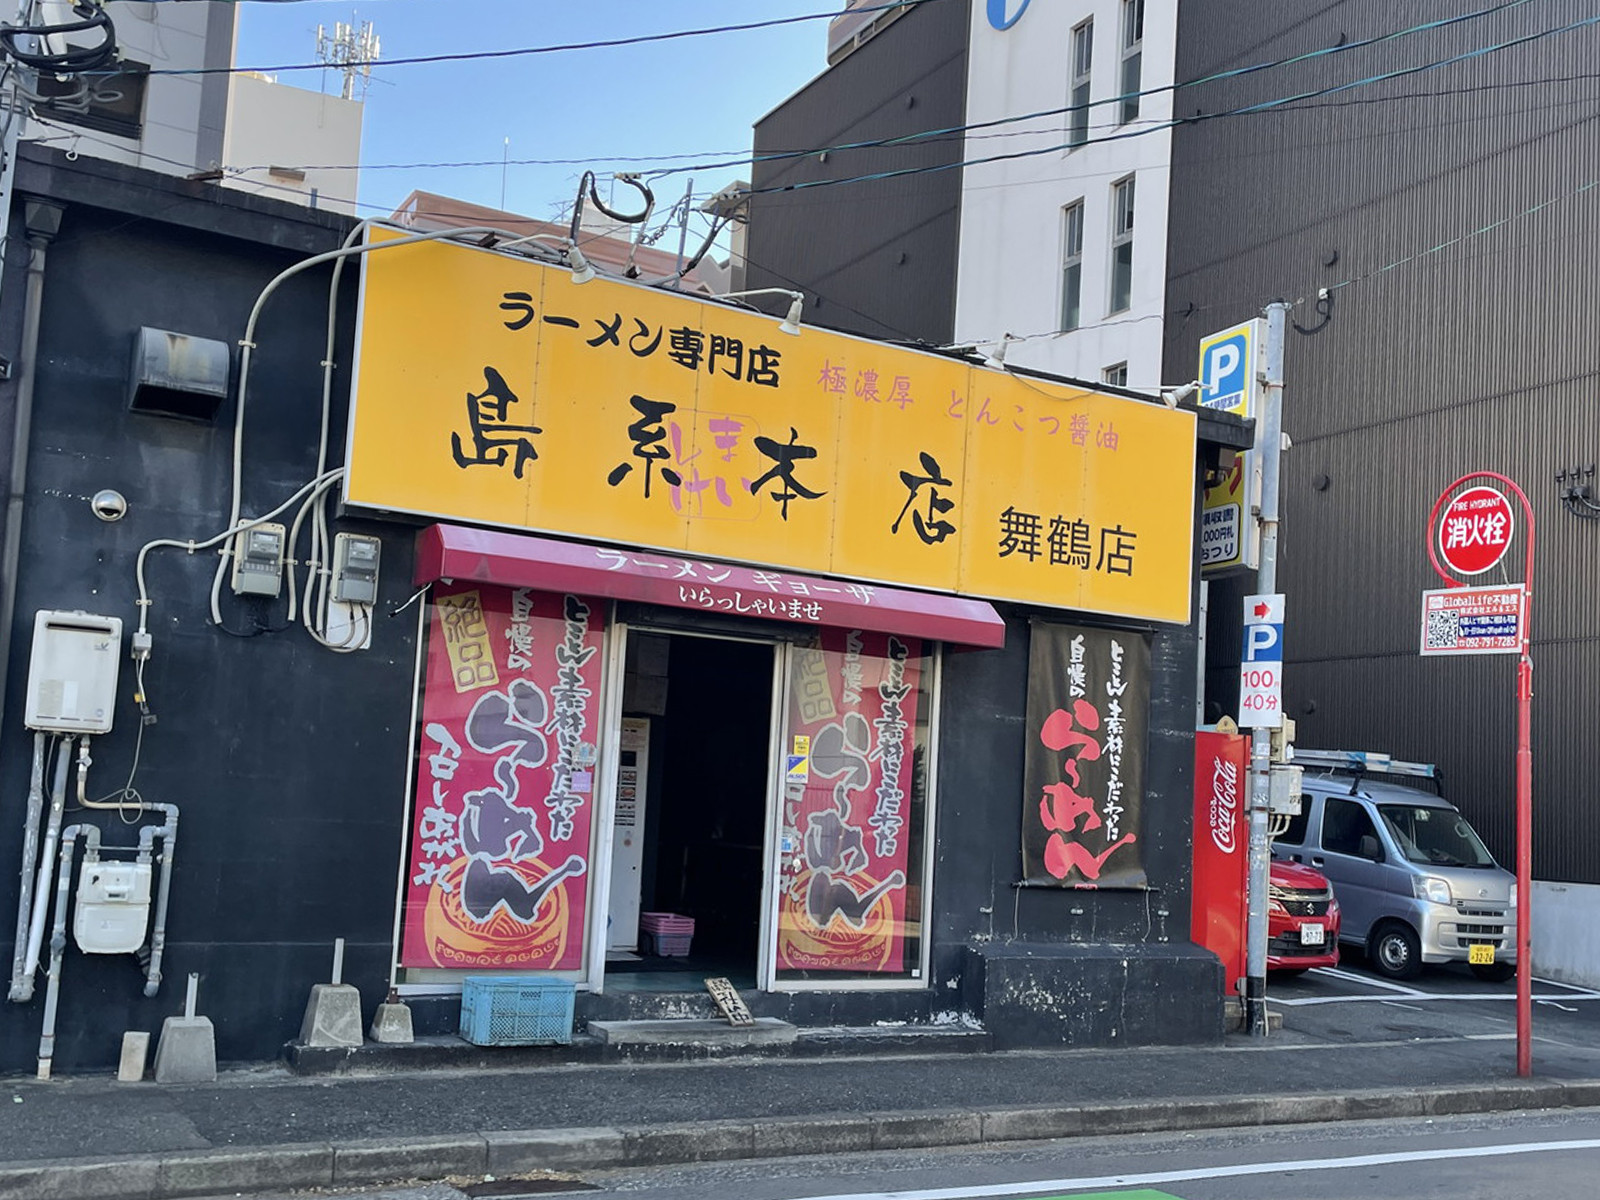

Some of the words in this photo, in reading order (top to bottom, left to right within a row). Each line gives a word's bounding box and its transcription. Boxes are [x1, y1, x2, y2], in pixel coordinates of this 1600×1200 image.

[499, 292, 781, 387] ラーメン専門店
[1209, 343, 1240, 396] P
[817, 358, 914, 410] 極濃厚
[948, 389, 1119, 451] とんこつ醤油
[999, 505, 1137, 577] 舞鶴店
[1446, 511, 1507, 549] 消火栓
[596, 548, 733, 583] ラーメン
[753, 569, 875, 604] ギョーザ
[679, 585, 823, 621] いらっしゃいませ
[1067, 634, 1086, 698] 自慢の
[1247, 625, 1278, 661] P
[1243, 694, 1278, 710] 40分
[459, 677, 587, 924] らーめん
[804, 711, 906, 930] らーめん
[1040, 699, 1137, 880] らーめん
